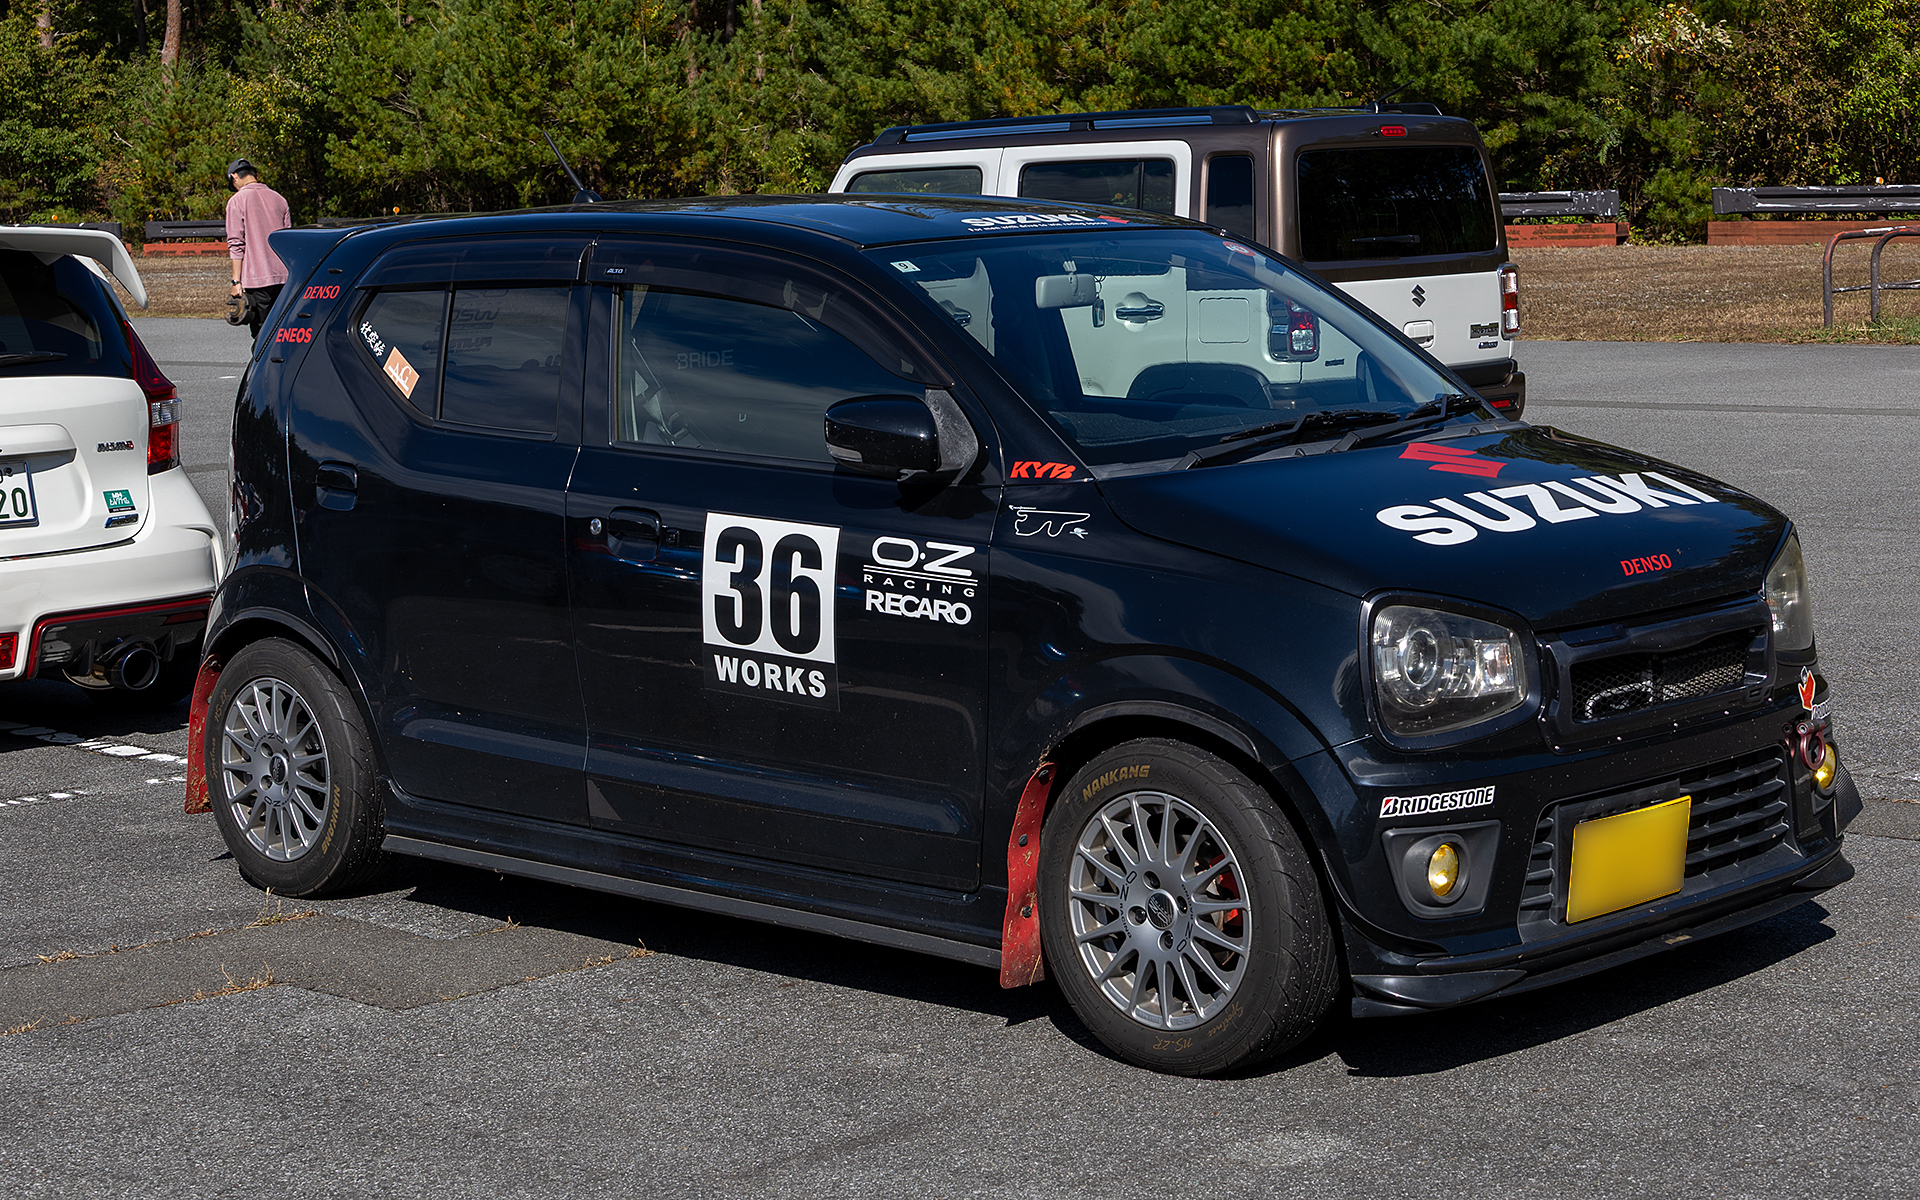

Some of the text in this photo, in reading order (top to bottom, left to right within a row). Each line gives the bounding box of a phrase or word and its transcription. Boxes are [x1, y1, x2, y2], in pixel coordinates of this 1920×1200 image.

[961, 213, 1095, 227] SUZUKI
[303, 286, 340, 300] DENSO
[276, 327, 313, 344] ENEOS
[676, 349, 734, 370] BRIDE
[1010, 460, 1077, 479] KYB
[1376, 471, 1720, 545] SUZUKI
[1620, 553, 1672, 576] DENSO
[715, 526, 822, 655] 36
[863, 574, 975, 598] RACING
[865, 590, 972, 626] RECARO
[714, 654, 827, 698] WORKS
[1082, 764, 1150, 802] NANKANG
[1381, 787, 1494, 817] BRIDGESTONE
[320, 784, 342, 855] NANKANG
